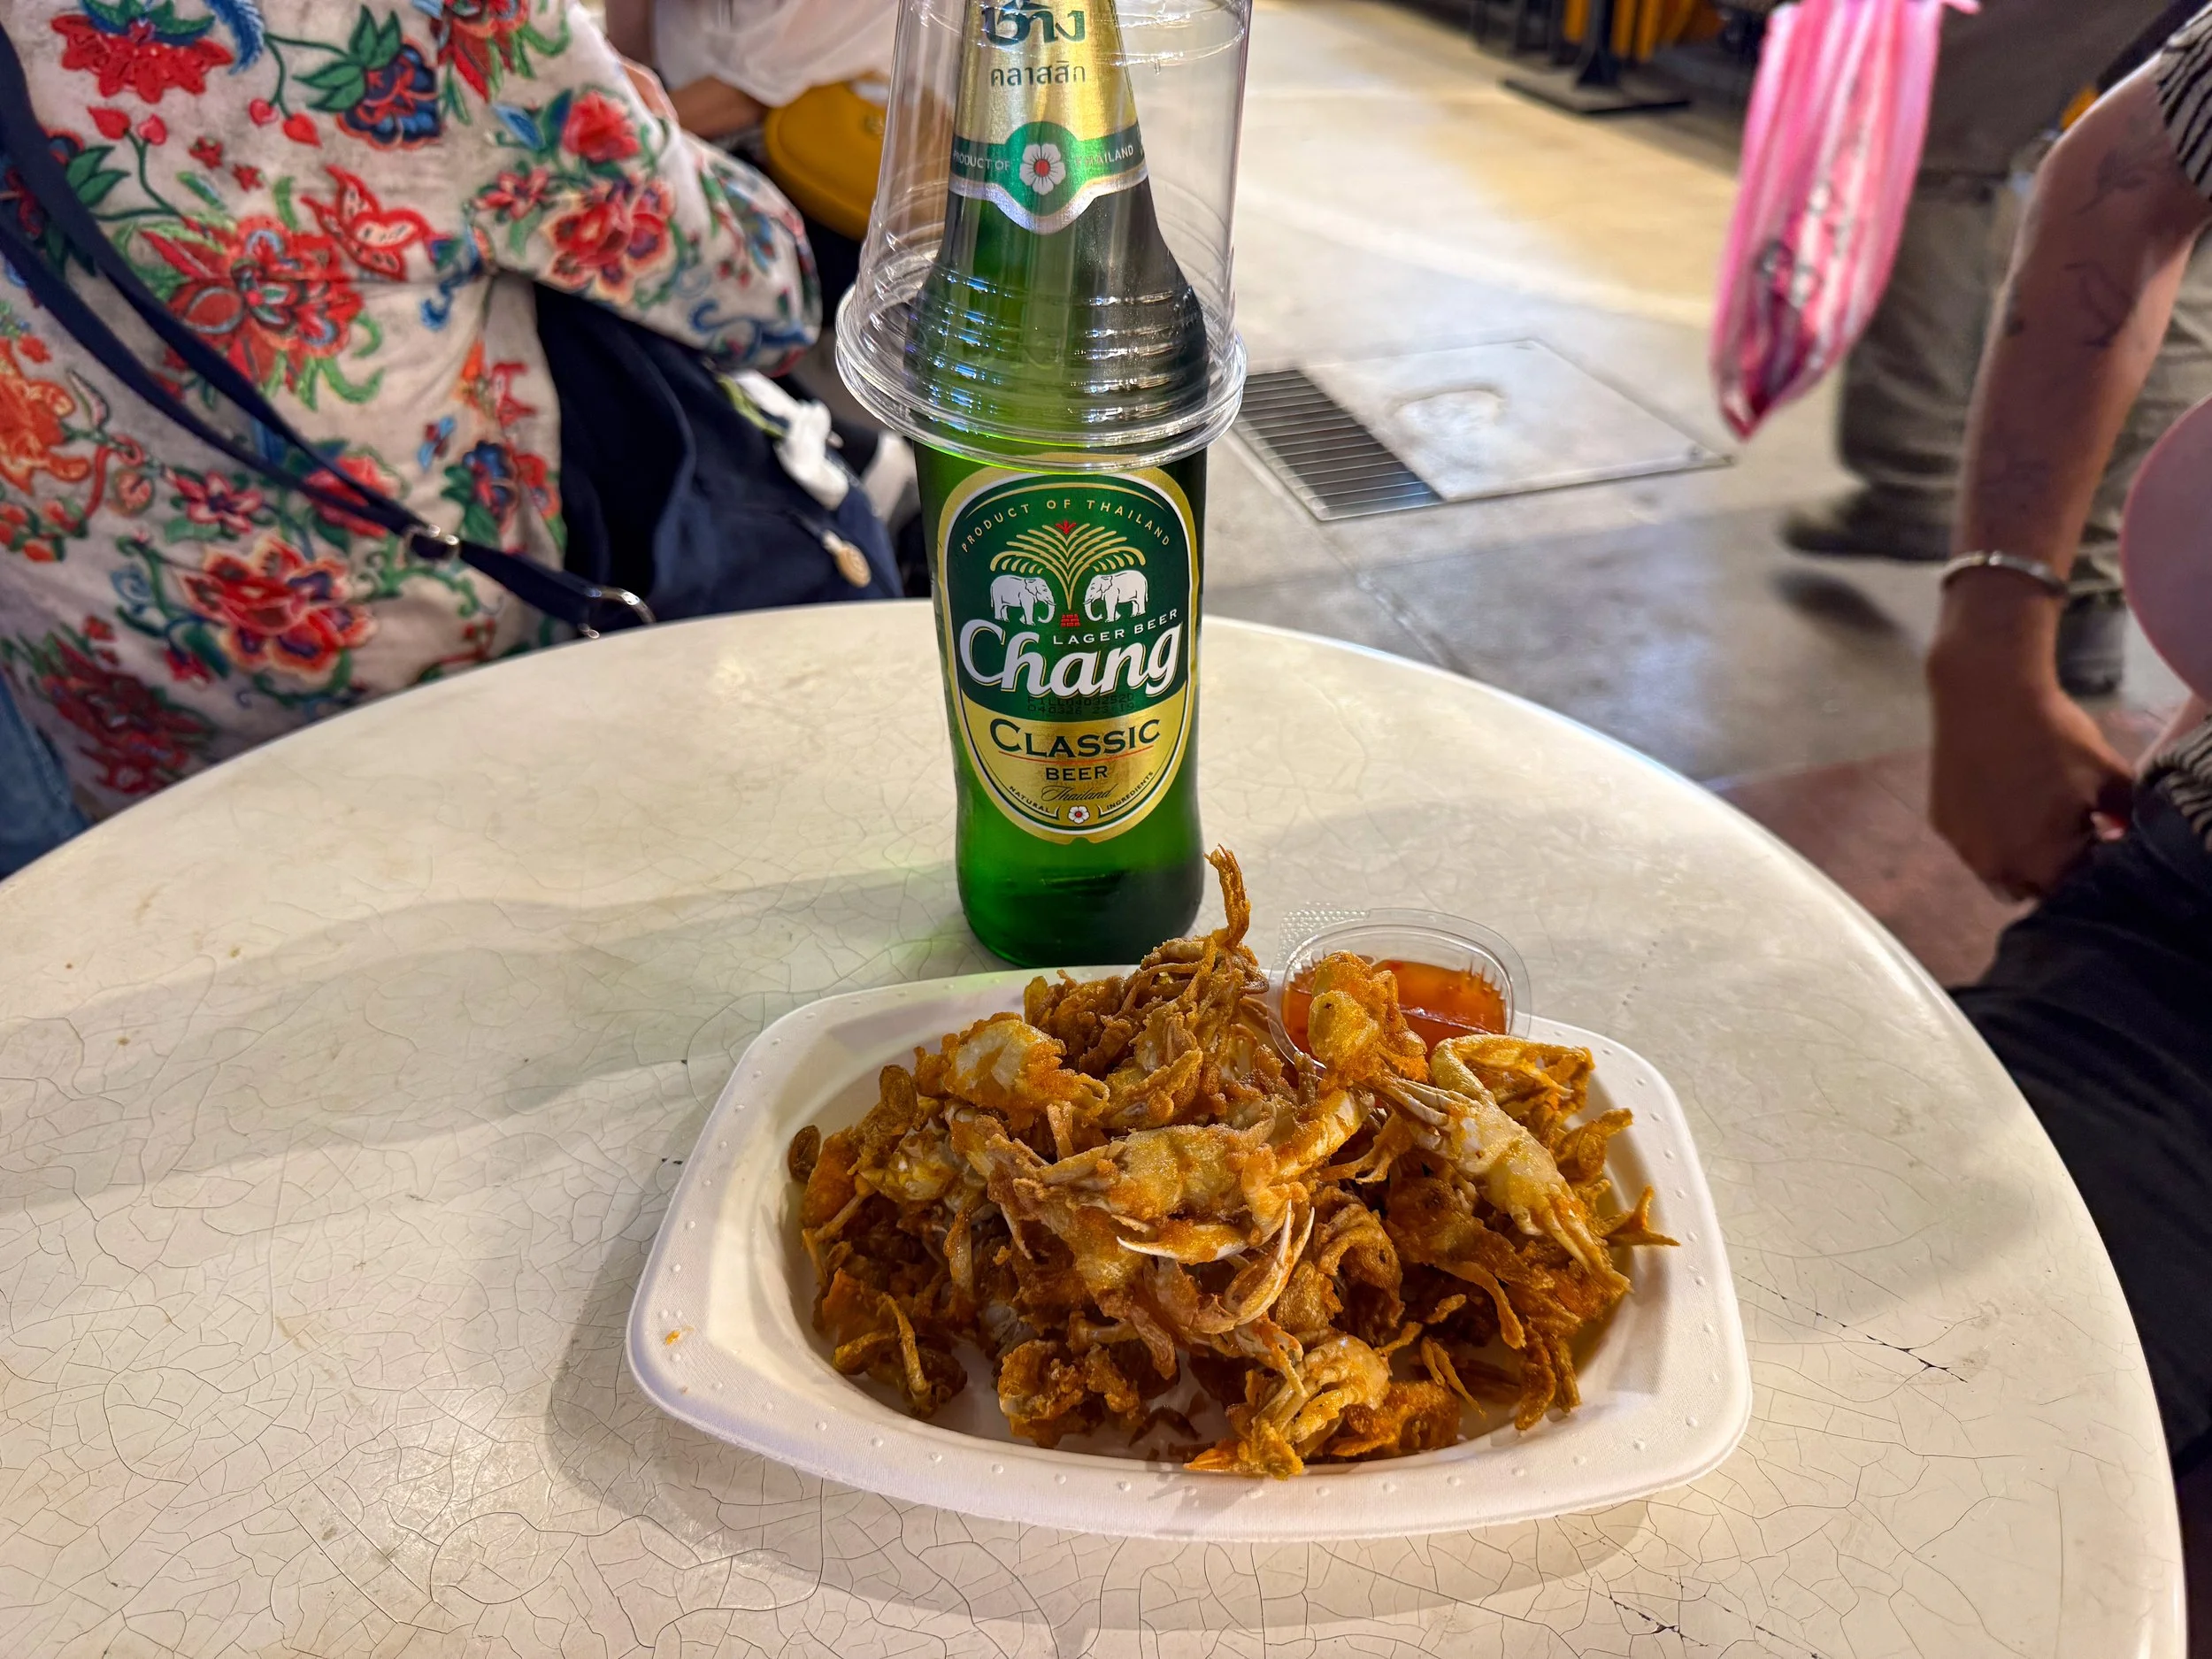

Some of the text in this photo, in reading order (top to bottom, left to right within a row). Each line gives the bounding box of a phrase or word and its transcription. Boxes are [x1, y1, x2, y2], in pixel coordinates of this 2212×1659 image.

[991, 60, 1086, 86] คลาสสิก
[953, 144, 1134, 171] PRODUCT OF THAILAND
[962, 499, 1170, 553] PRODUCT OF THAILAND
[1053, 608, 1178, 645] LAGER BEER
[959, 618, 1183, 698] Chang
[989, 718, 1161, 759] CLASSIC
[1046, 765, 1109, 781] BEER
[1010, 786, 1051, 813] NATURAL
[1041, 783, 1118, 802] Thailand
[1106, 772, 1154, 810] INGREDIENTS
